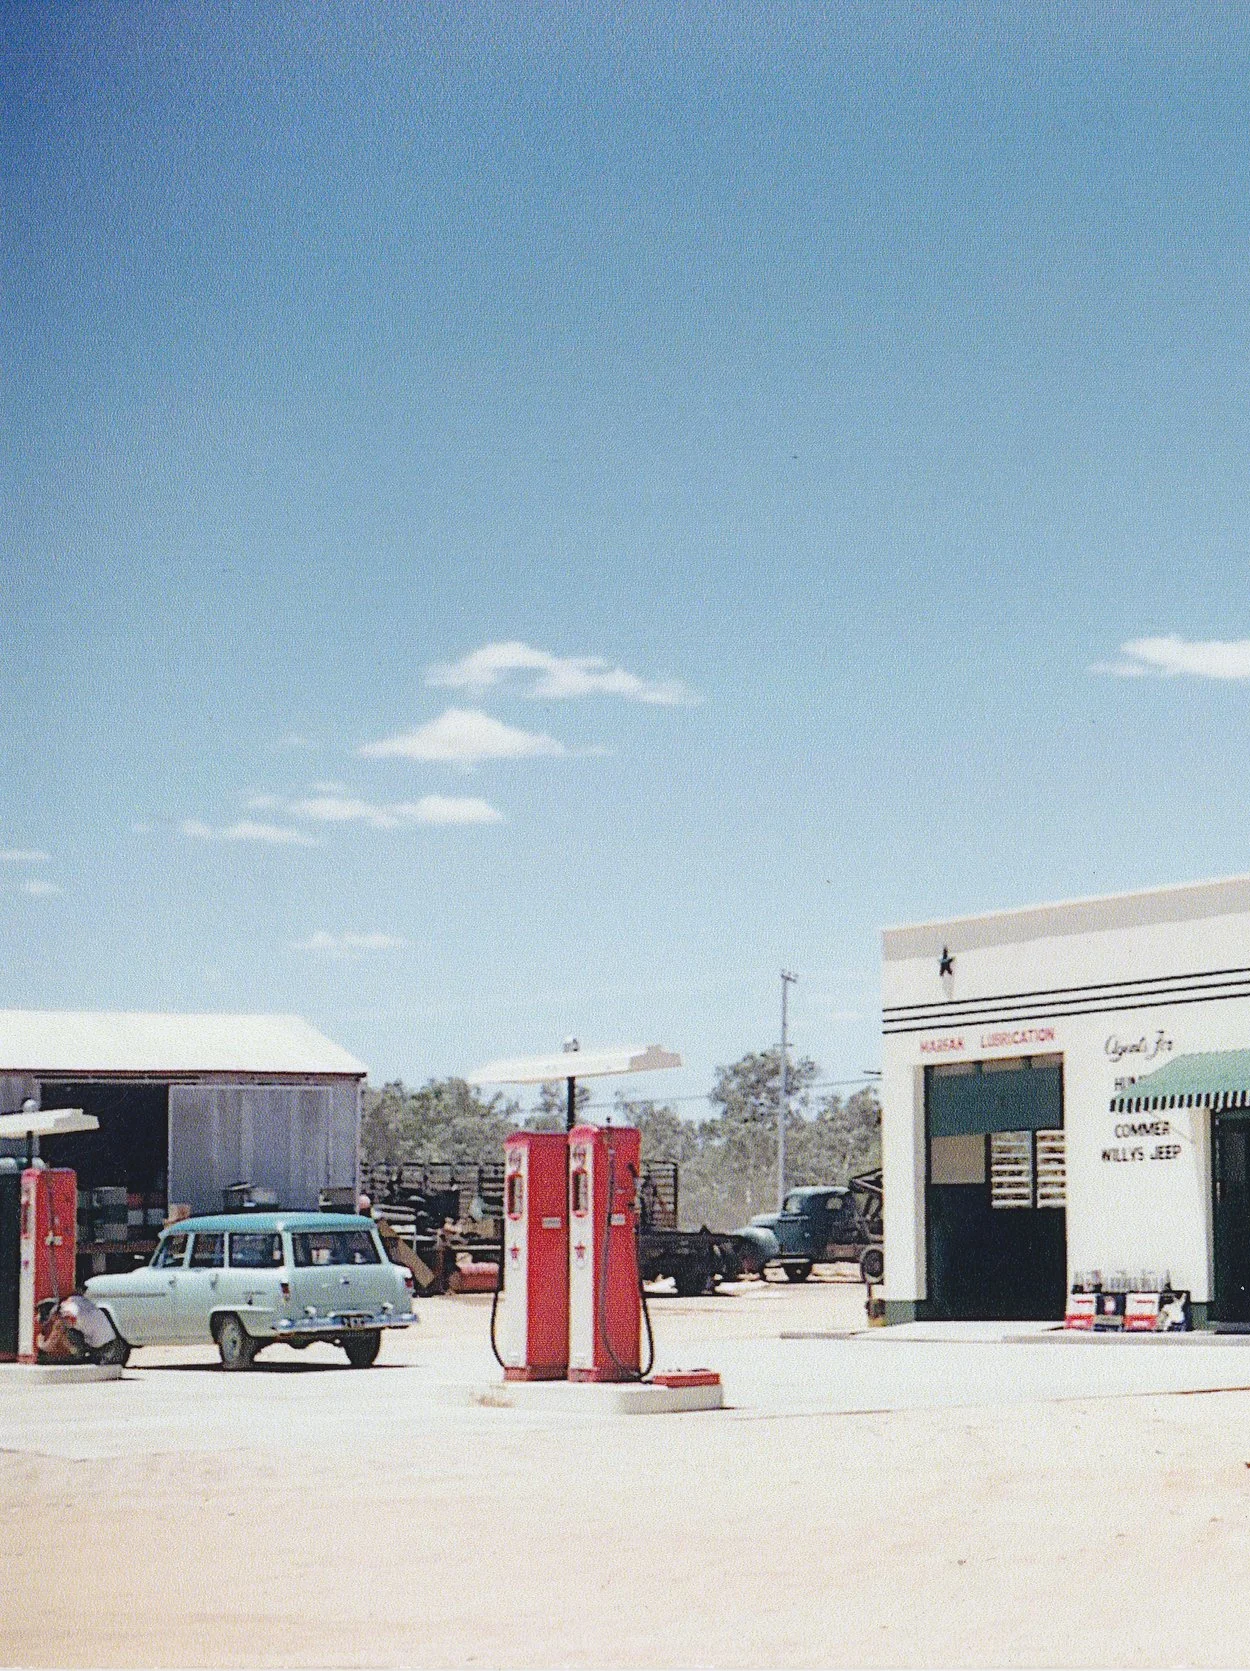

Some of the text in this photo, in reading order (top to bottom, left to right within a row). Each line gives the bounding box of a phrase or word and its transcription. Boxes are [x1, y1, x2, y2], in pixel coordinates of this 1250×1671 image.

[980, 1027, 1056, 1049] LUBRICATION
[1114, 1121, 1170, 1139] COMMER
[1101, 1144, 1182, 1162] WILLYS JEEP
